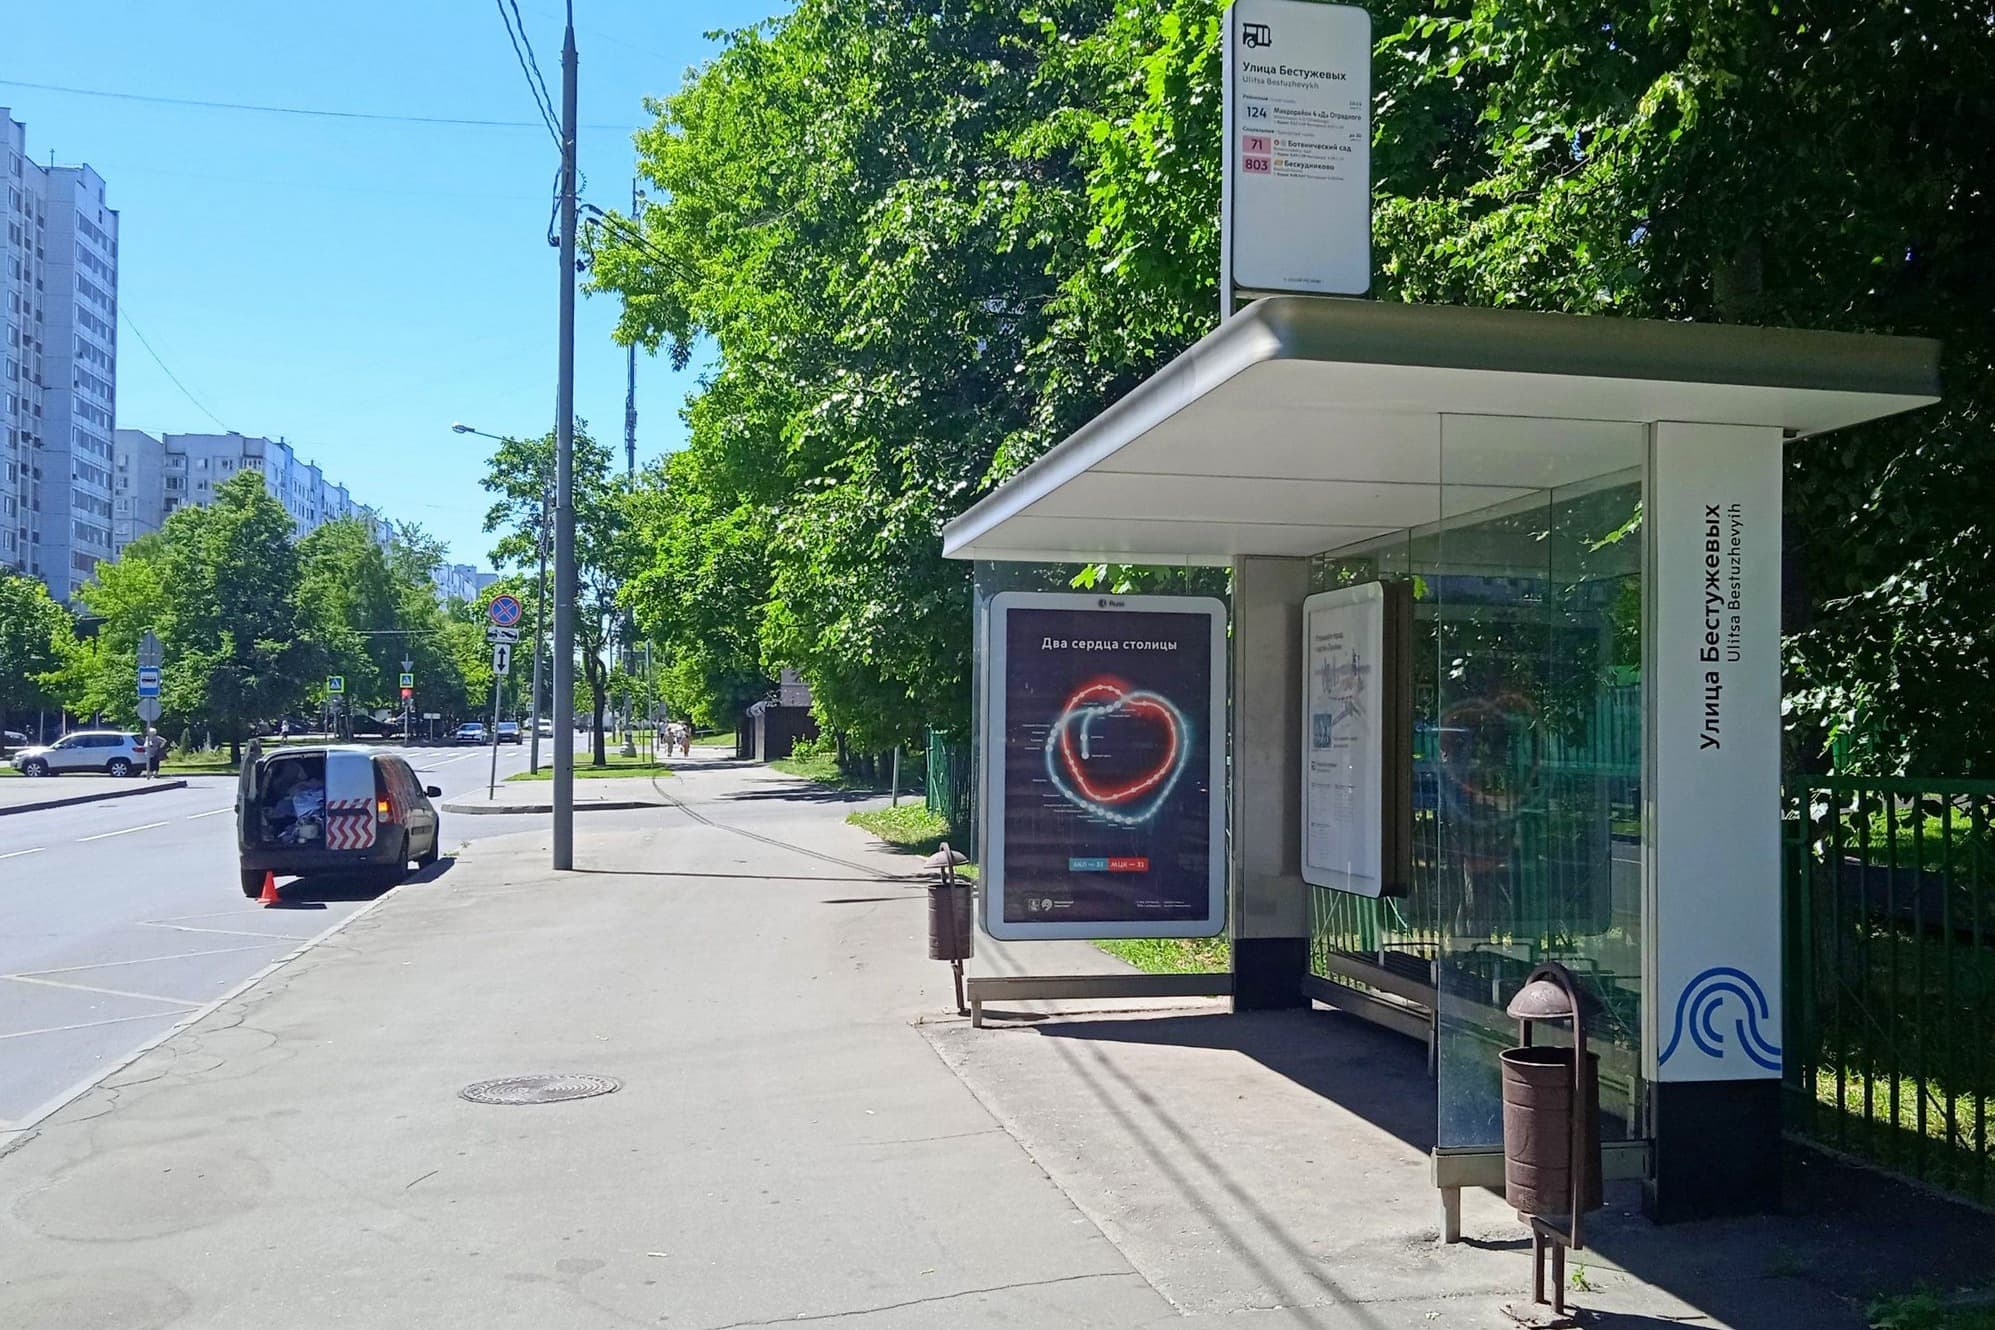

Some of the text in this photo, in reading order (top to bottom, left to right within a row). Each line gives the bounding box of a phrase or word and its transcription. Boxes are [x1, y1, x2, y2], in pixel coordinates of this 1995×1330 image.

[1242, 61, 1346, 80] Улица Бестужевых
[1242, 76, 1265, 84] Ulitsa
[1247, 106, 1267, 118] 124
[1251, 138, 1263, 150] 71
[1245, 159, 1268, 171] 803
[1727, 503, 1744, 662] Ulitsa Bestuzhevyih
[1700, 503, 1724, 750] Улица Бестужевых
[1041, 637, 1177, 651] Два сердца столицы
